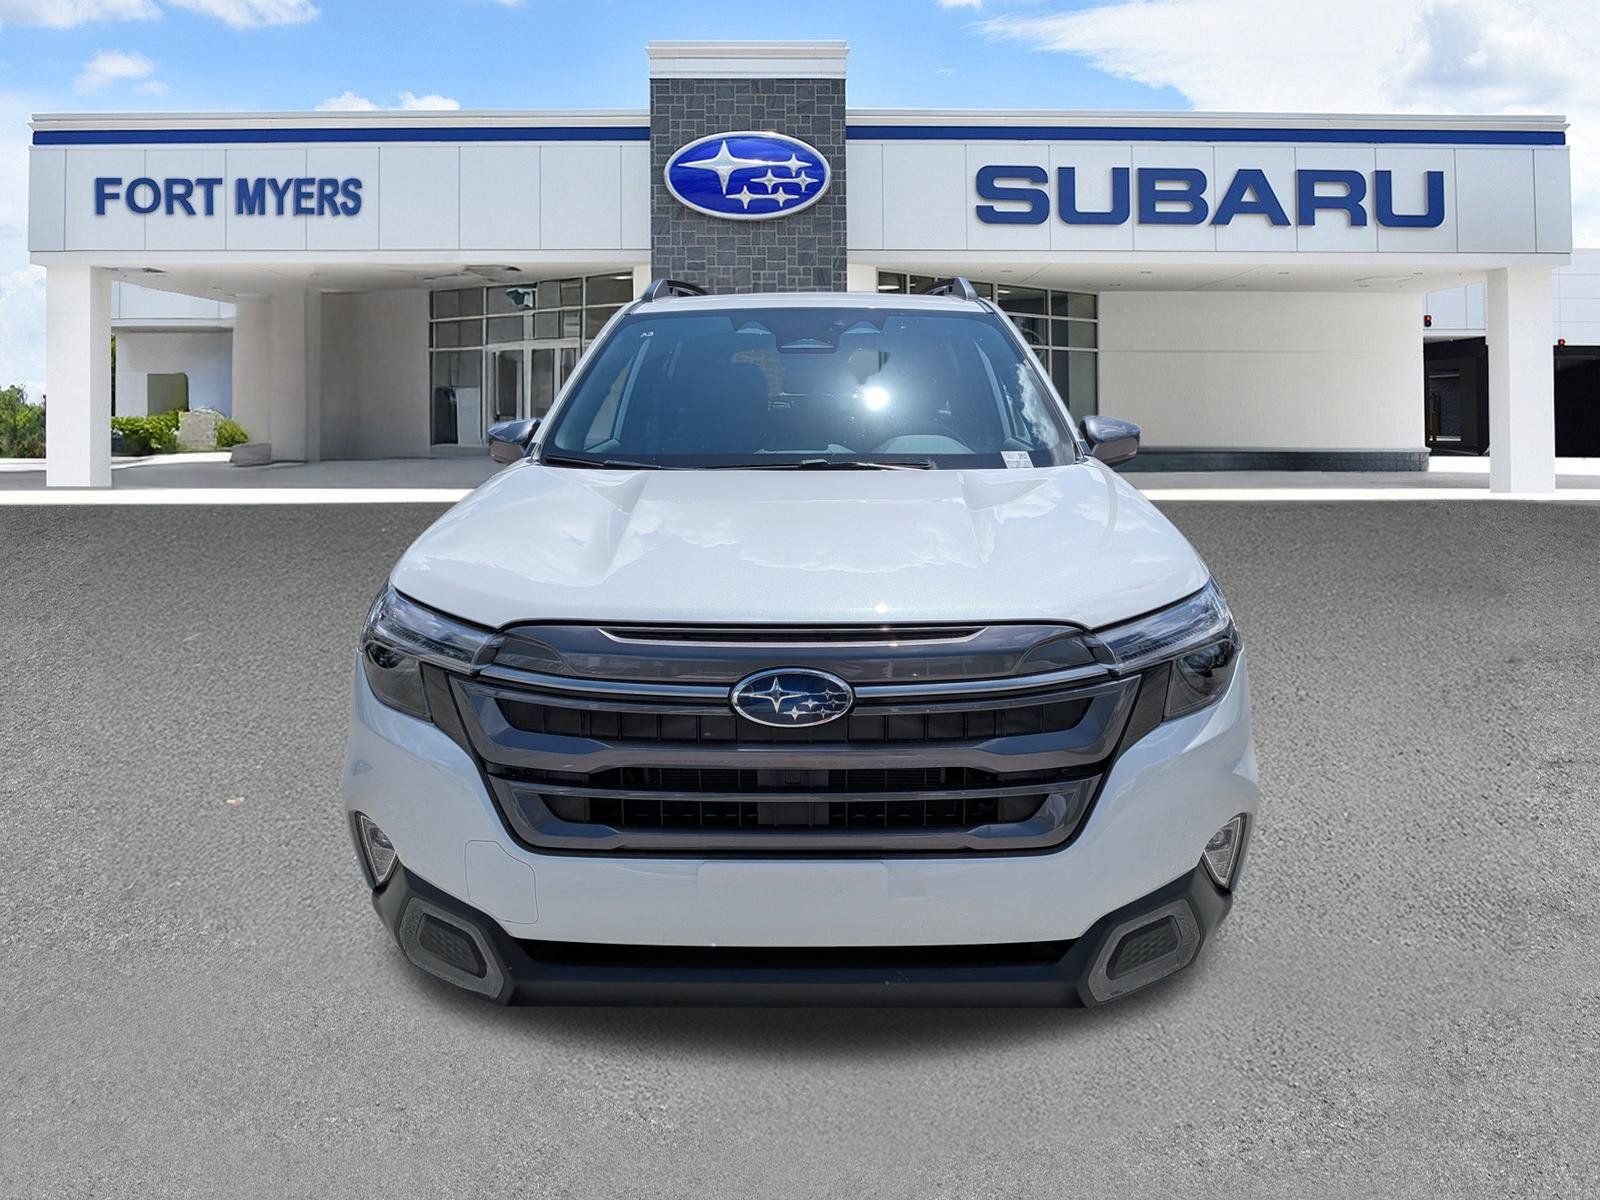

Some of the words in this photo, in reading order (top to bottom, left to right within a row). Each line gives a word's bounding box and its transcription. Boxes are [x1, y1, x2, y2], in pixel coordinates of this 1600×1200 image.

[94, 177, 223, 216] FORT
[235, 177, 363, 217] MYERS
[976, 165, 1446, 228] SUBARU
